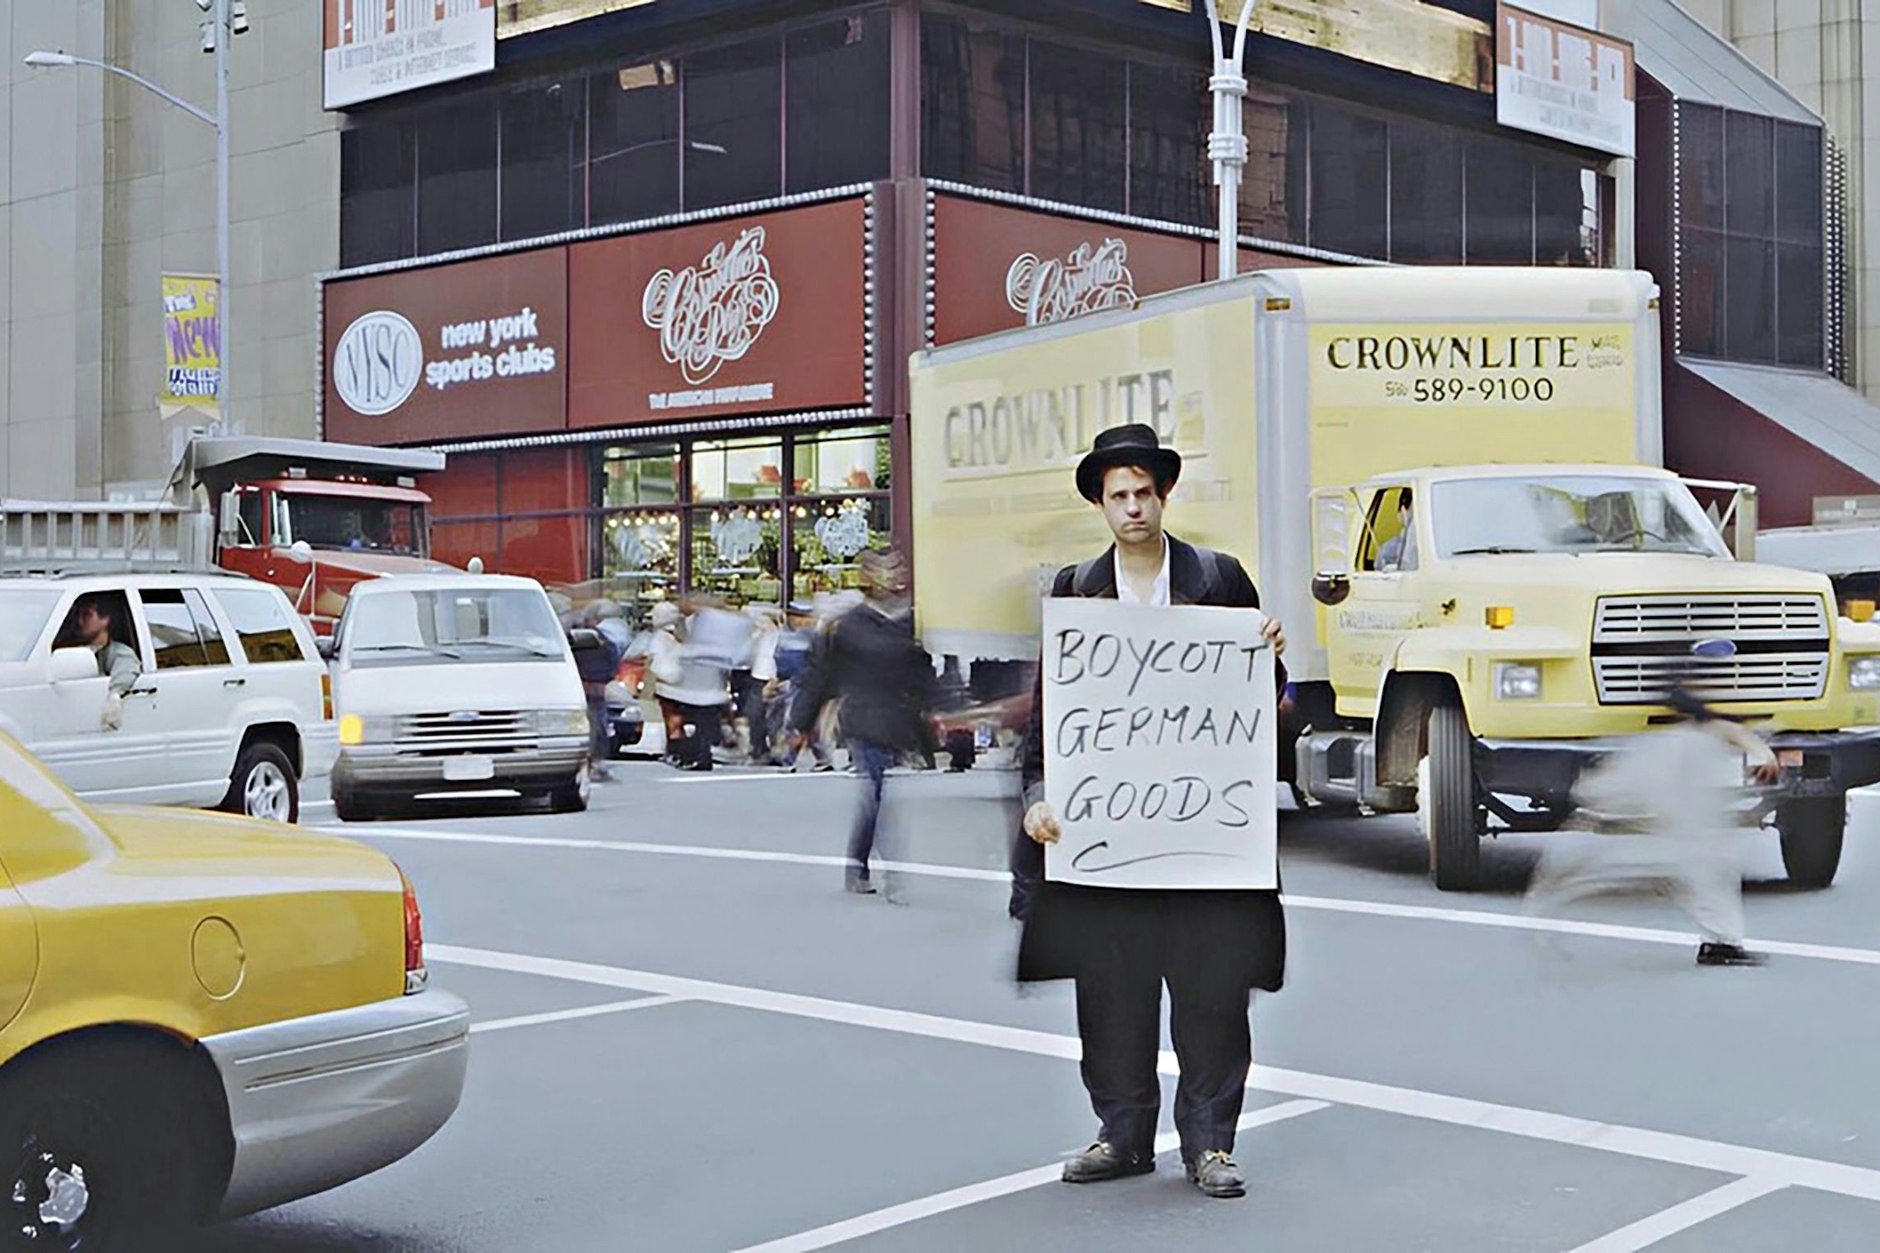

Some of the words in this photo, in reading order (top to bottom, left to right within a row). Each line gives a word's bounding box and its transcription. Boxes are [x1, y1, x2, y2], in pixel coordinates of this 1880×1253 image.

[441, 319, 486, 349] new
[489, 307, 538, 348] york
[425, 351, 494, 390] sports
[496, 342, 556, 377] clubs
[1327, 336, 1578, 370] CROWNLITE
[1413, 376, 1554, 402] 589-9100
[1049, 628, 1269, 697] BOYCOTT
[1057, 705, 1262, 758] GERMAN
[1064, 775, 1254, 828] GOODS
